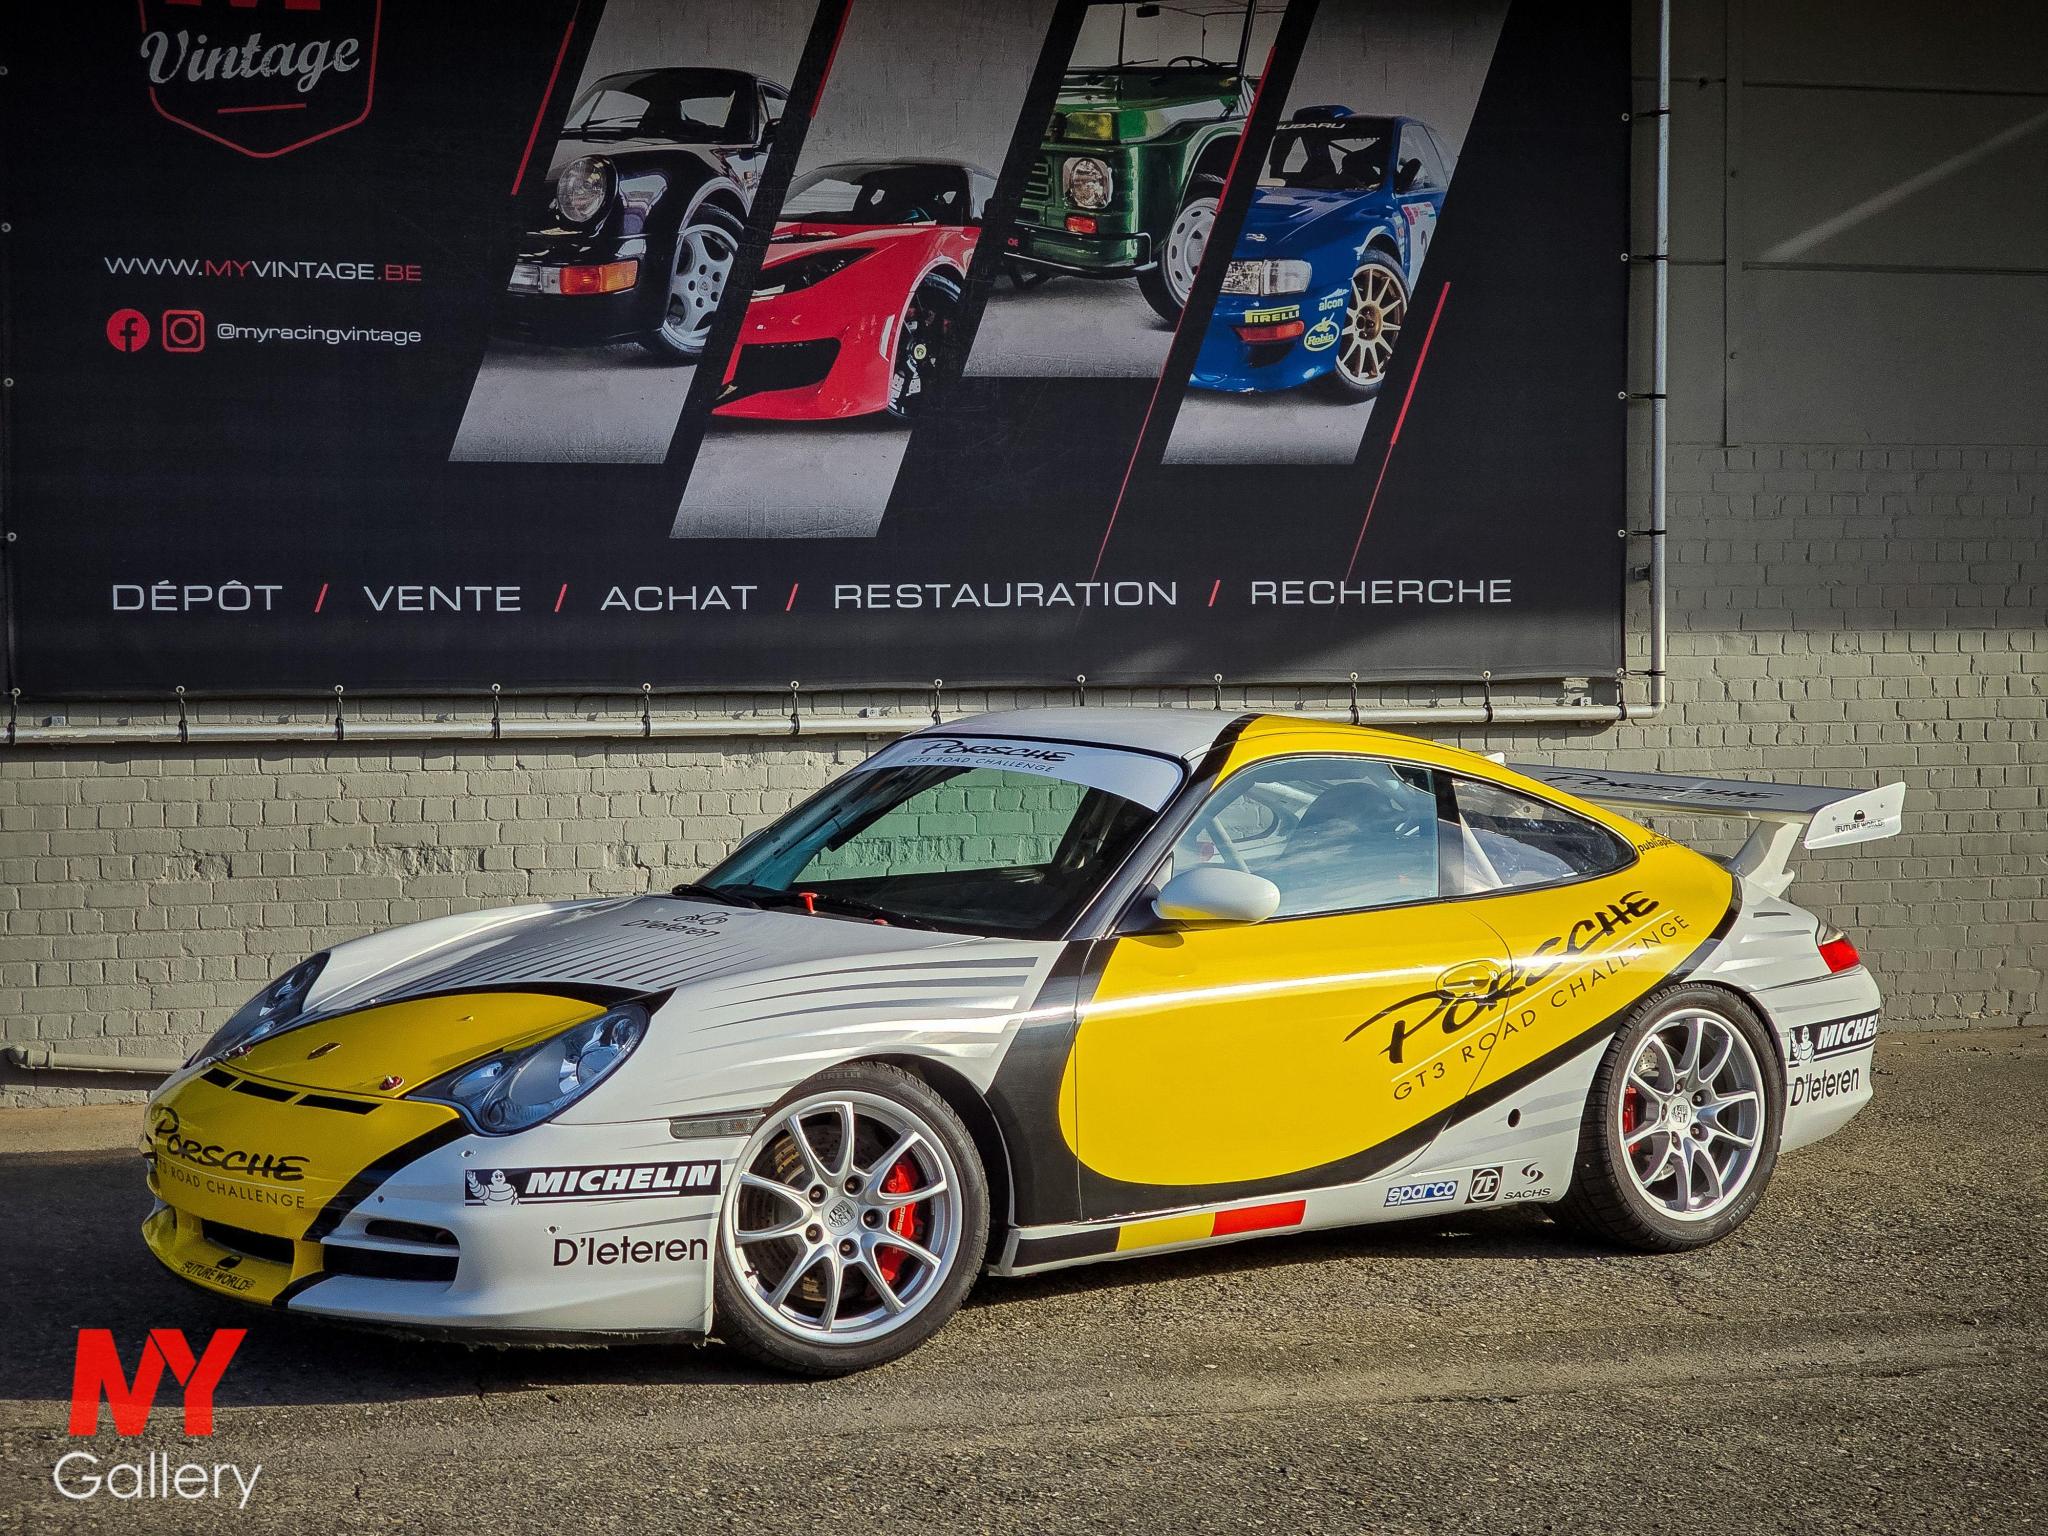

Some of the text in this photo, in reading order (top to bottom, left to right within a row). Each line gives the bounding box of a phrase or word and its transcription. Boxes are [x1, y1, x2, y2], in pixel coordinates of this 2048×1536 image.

[140, 29, 360, 92] Vintage
[104, 257, 422, 281] WWW.MYVINTAGE.BE
[1244, 304, 1300, 323] PIRELLI
[1319, 298, 1344, 312] alcon
[216, 322, 422, 345] @myracingvintage
[112, 579, 283, 612] DÉPÔT
[363, 586, 521, 611] VENTE
[600, 585, 758, 611] ACHAT
[835, 580, 1178, 608] RESTAURATION
[1251, 579, 1512, 606] RECHERCHE
[921, 739, 1075, 762] PORSCHE
[975, 758, 1056, 773] CHALLENGE
[1343, 890, 1660, 1064] PORSCHE
[1393, 915, 1690, 1100] GT3 ROAD CHALLENGE
[1817, 1013, 1879, 1050] MICHEL
[143, 1106, 311, 1182] PORSCHE
[171, 1166, 201, 1188] ROAD
[206, 1180, 305, 1210] CHALLENGE
[525, 1164, 718, 1194] MICHELIN
[1473, 1174, 1496, 1197] ZF
[1386, 1181, 1457, 1206] sparco
[1504, 1187, 1552, 1200] SACHS
